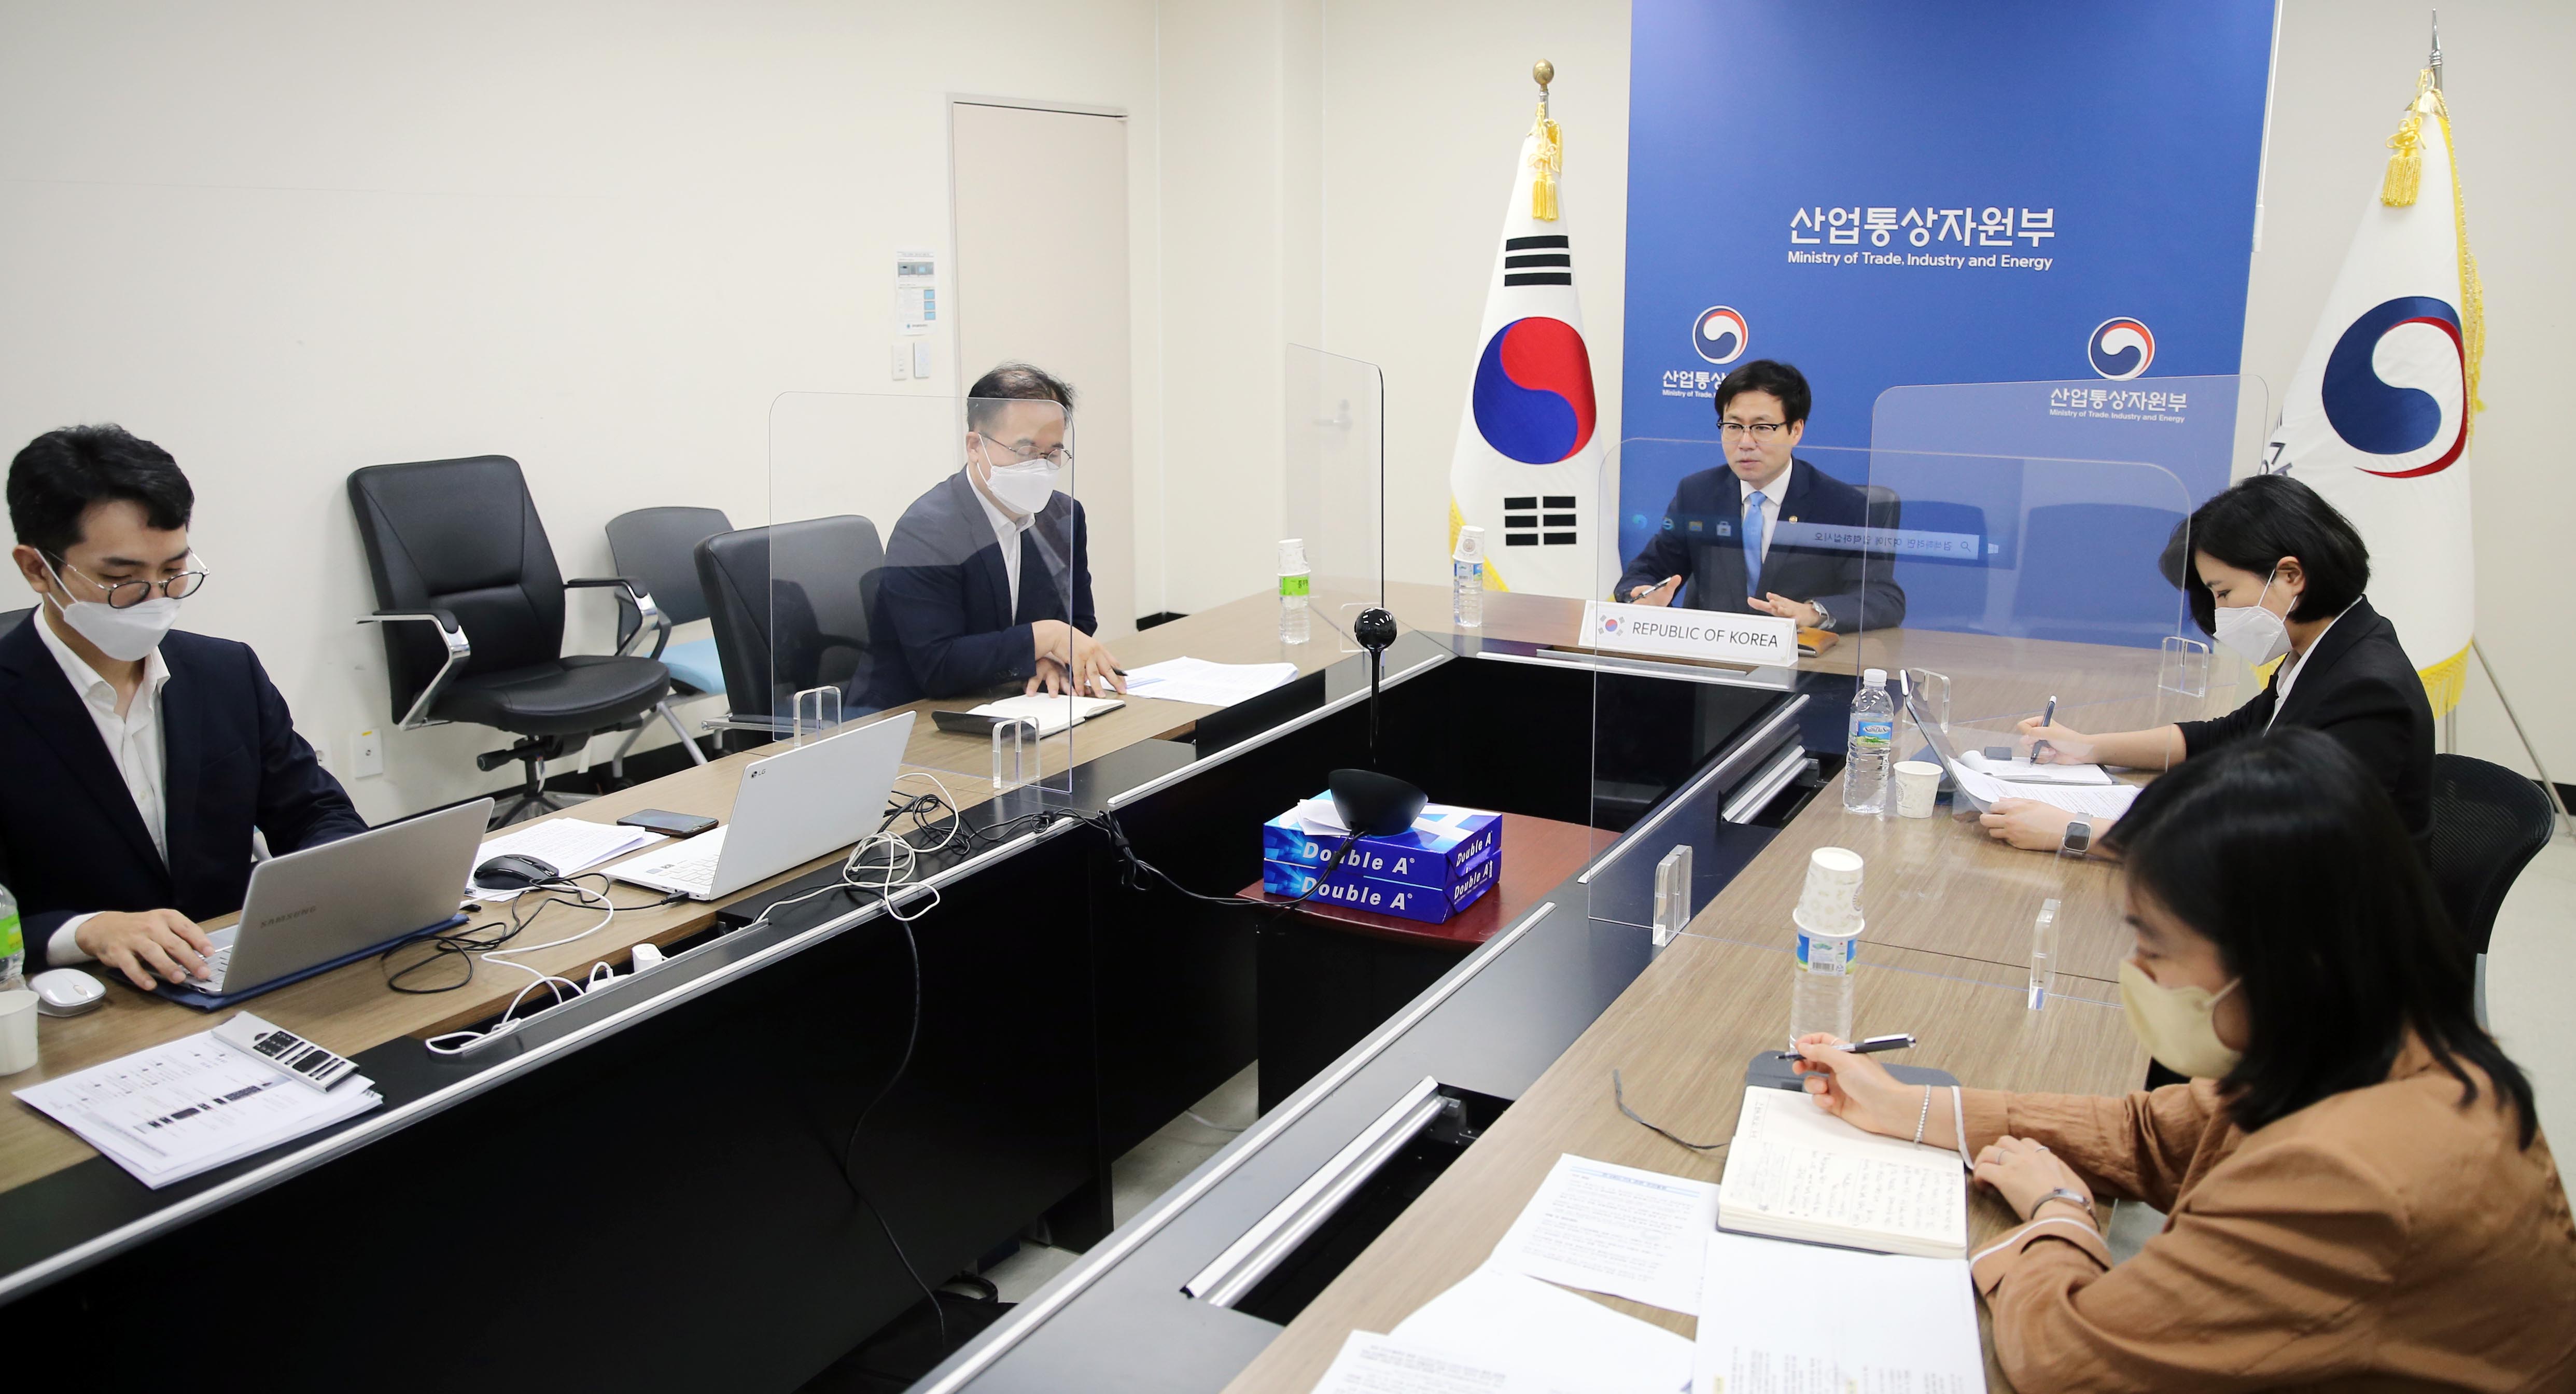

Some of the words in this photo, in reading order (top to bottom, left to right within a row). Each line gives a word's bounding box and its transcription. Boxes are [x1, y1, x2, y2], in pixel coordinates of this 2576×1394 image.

[1790, 206, 2055, 247] 산업통상자원부
[1787, 250, 1841, 267] Ministry
[1844, 252, 1858, 264] of
[1862, 252, 1904, 266] Trade,
[1907, 253, 1966, 269] Industry
[1968, 255, 1996, 267] and
[2000, 255, 2053, 271] Energy
[1662, 370, 1729, 390] 산업통상
[1662, 389, 1685, 398] Ministry
[2050, 388, 2187, 412] 산업통상자원부
[2050, 409, 2077, 417] Ministry
[2111, 412, 2141, 421] Industry
[2159, 414, 2185, 423] Energy
[1632, 622, 1699, 640] REPUBLIC
[1704, 629, 1725, 642] OF
[1729, 631, 1778, 648] KOREA
[1456, 840, 1483, 867] Double
[1301, 876, 1381, 905] Double
[1454, 872, 1481, 900] Double
[260, 905, 316, 929] SAMSUNG
